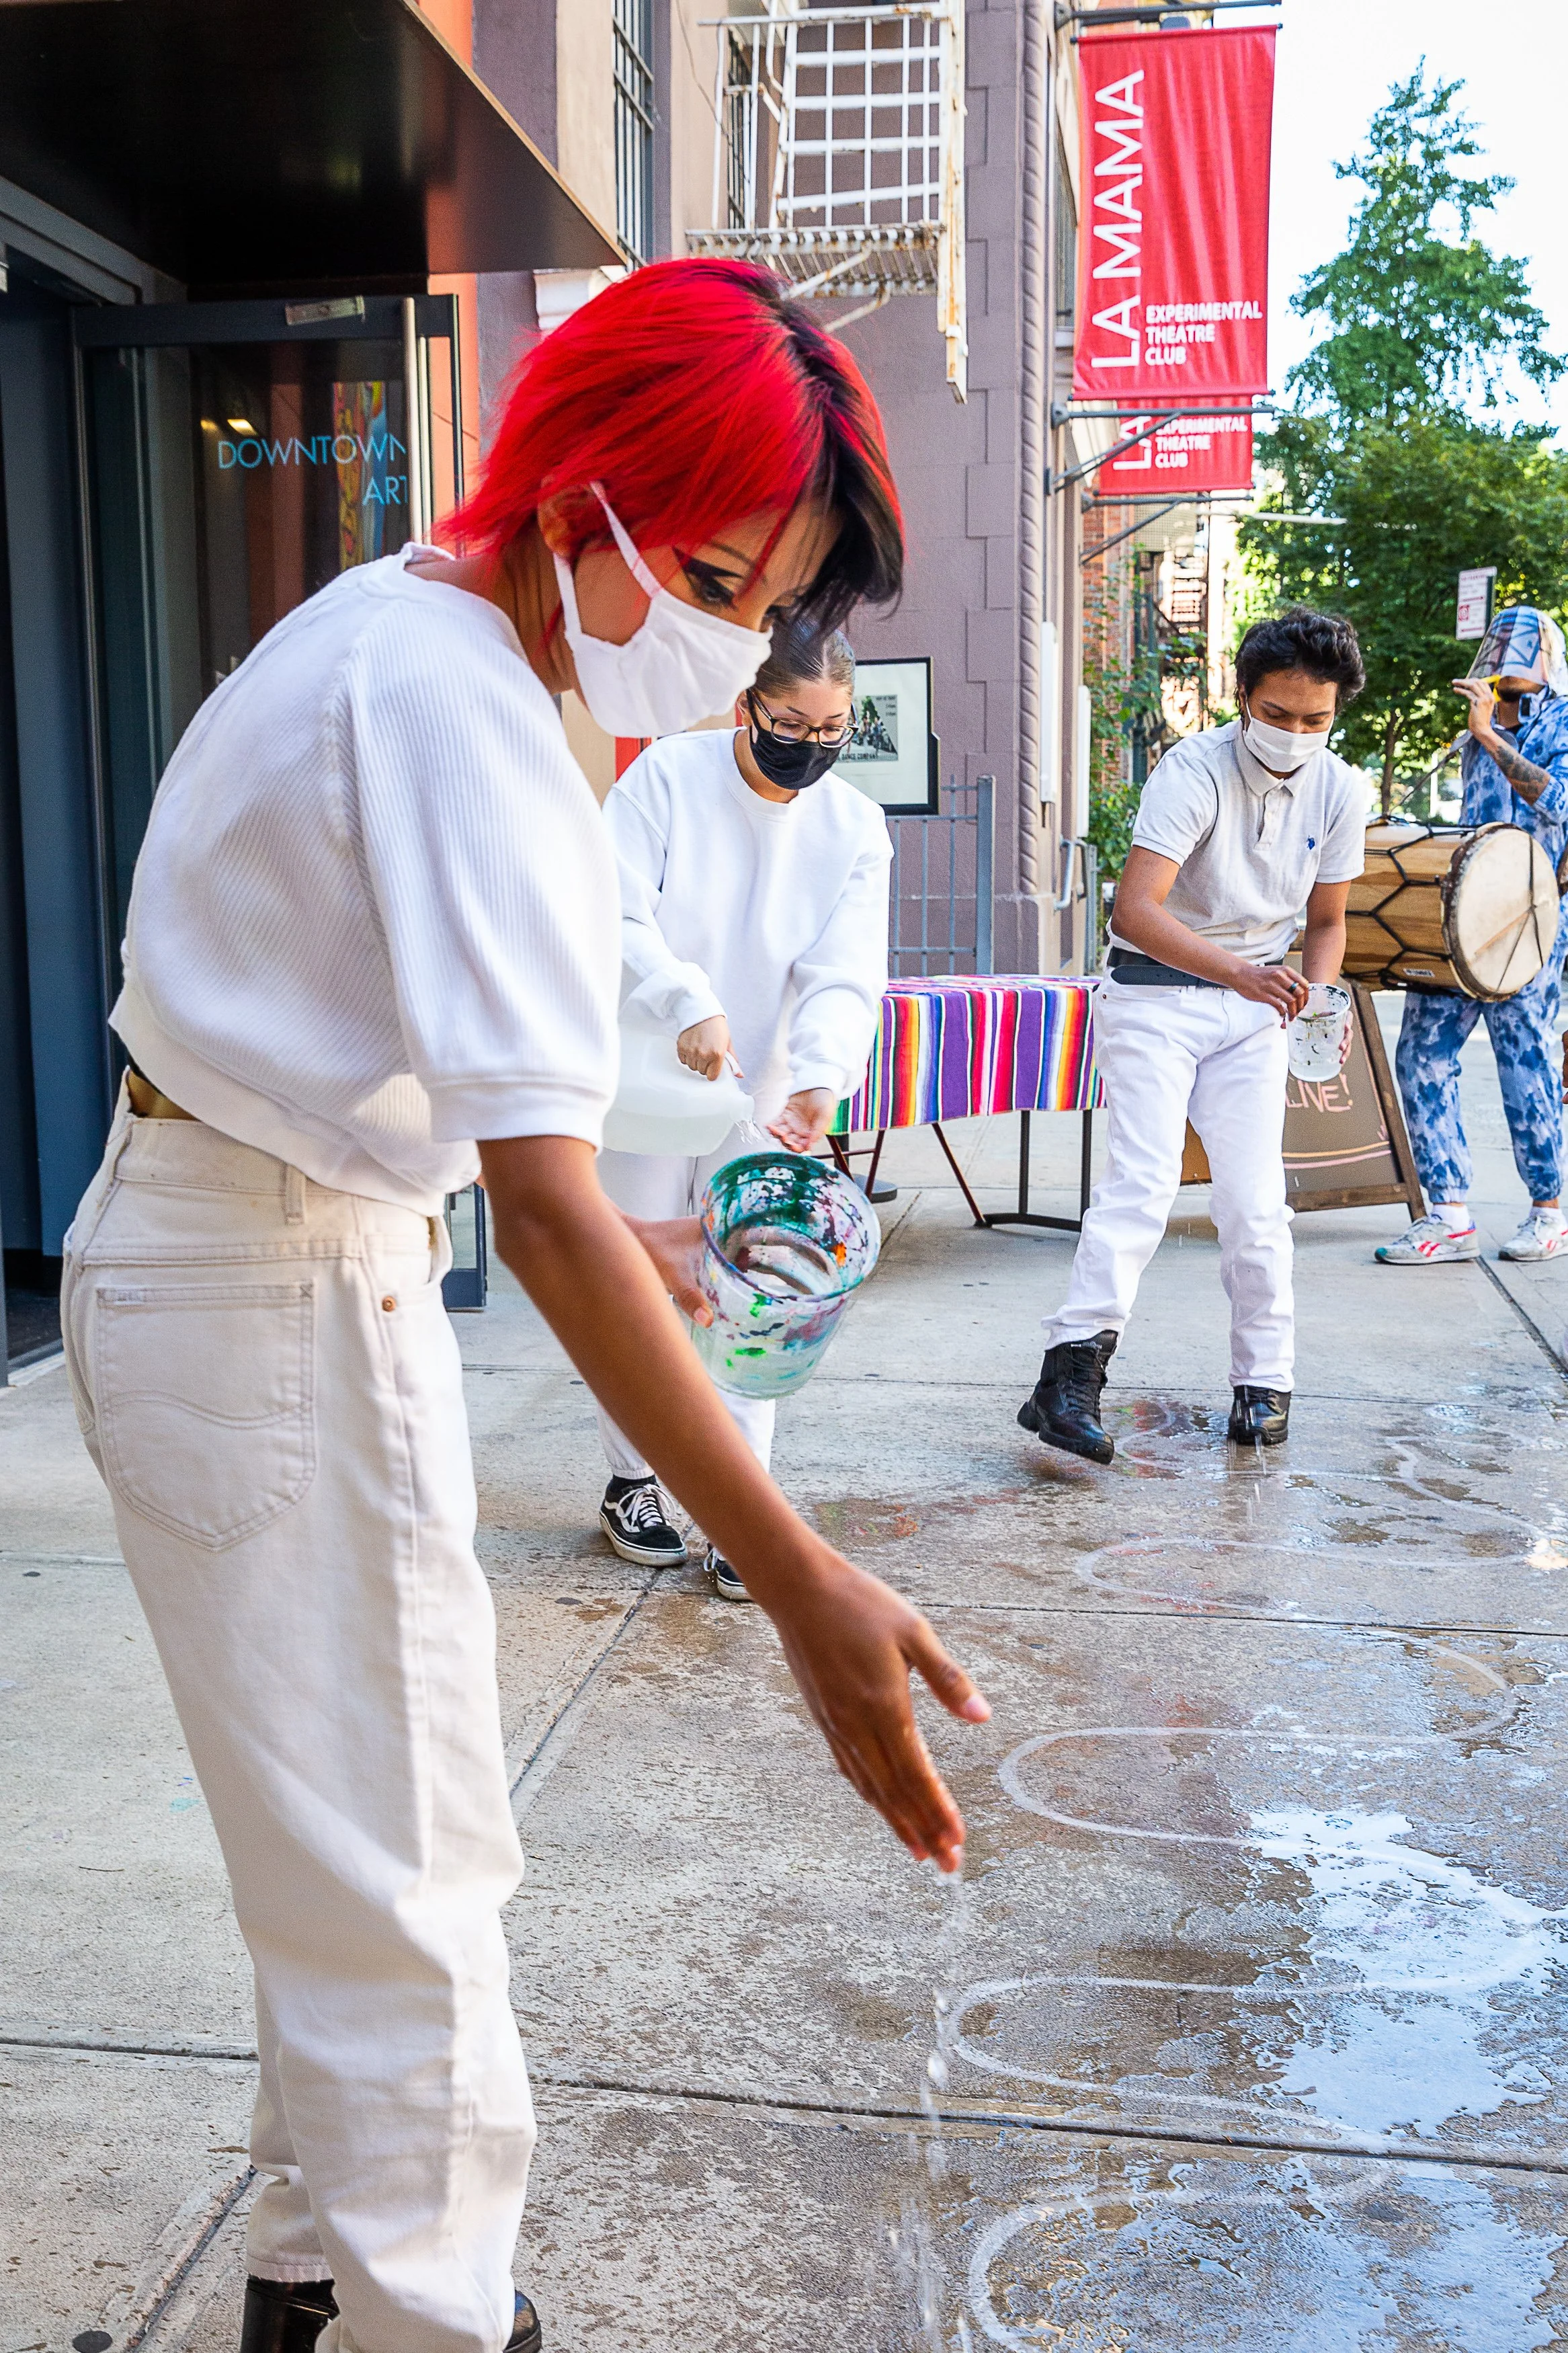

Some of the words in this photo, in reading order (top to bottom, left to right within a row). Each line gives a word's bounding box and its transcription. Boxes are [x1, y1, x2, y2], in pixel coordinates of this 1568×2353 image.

[1093, 69, 1144, 279] MAMA
[1146, 301, 1262, 324] EXPERIMENTAL
[1091, 294, 1141, 368] LA
[1145, 324, 1215, 345] THEATRE
[1145, 346, 1187, 366] CLUB
[1155, 416, 1248, 436] XPERIMENTAL
[1155, 434, 1210, 452] THEATRE
[1155, 451, 1188, 469] CLUB
